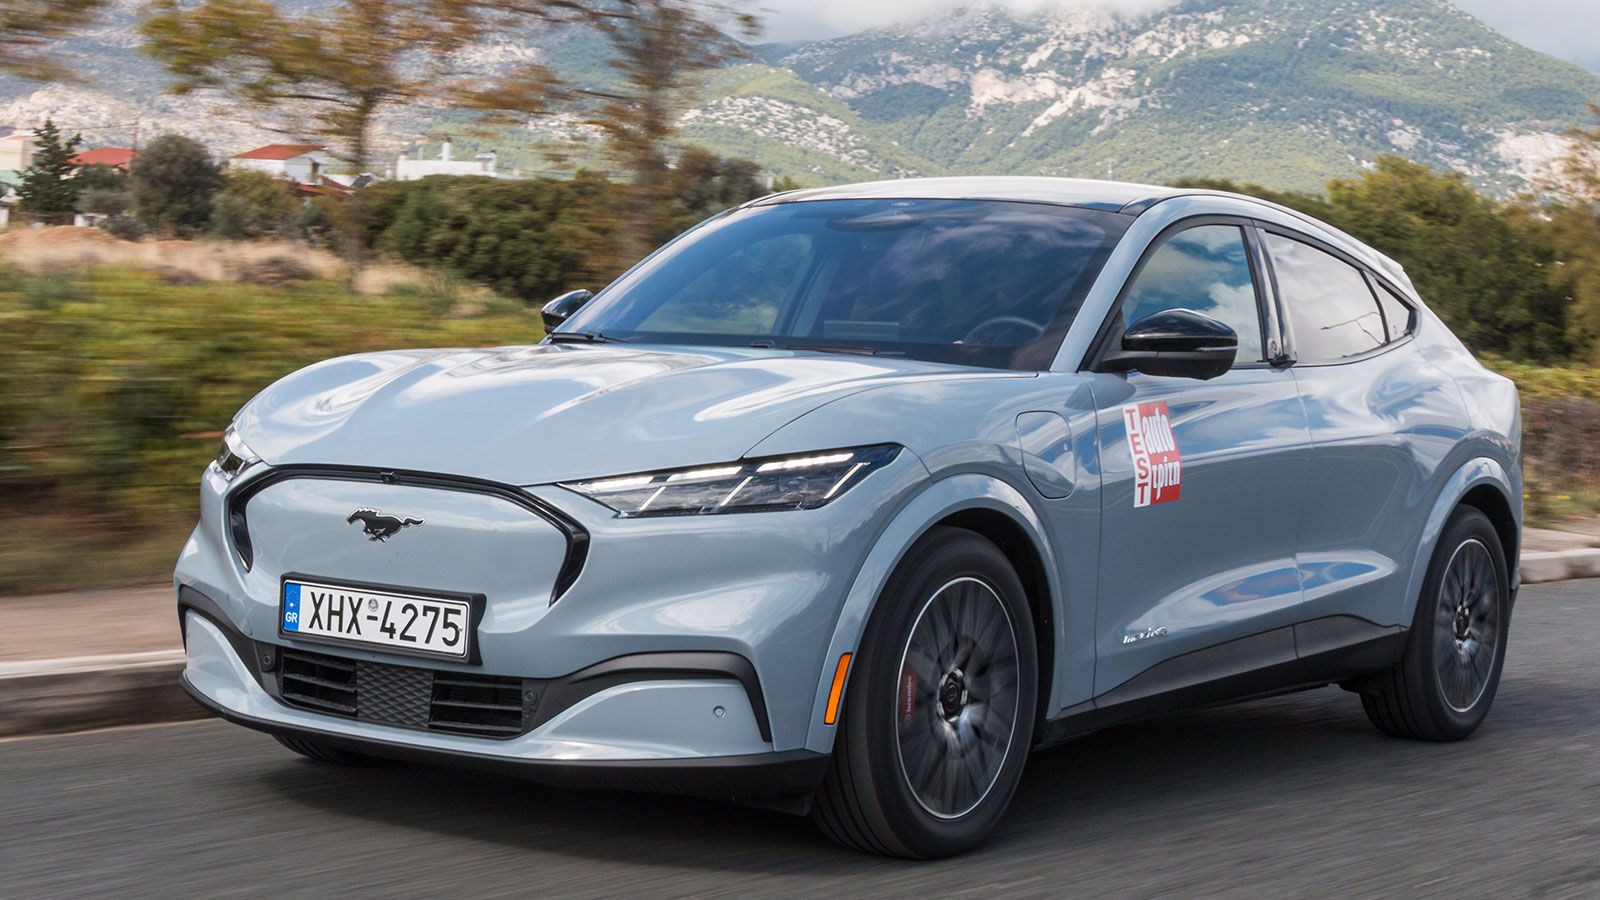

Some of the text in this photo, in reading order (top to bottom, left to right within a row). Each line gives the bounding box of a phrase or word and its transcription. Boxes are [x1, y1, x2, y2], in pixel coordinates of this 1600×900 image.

[1142, 407, 1175, 454] auto
[1125, 408, 1149, 505] TEST
[285, 612, 298, 623] GR
[308, 591, 462, 647] XHX-4275
